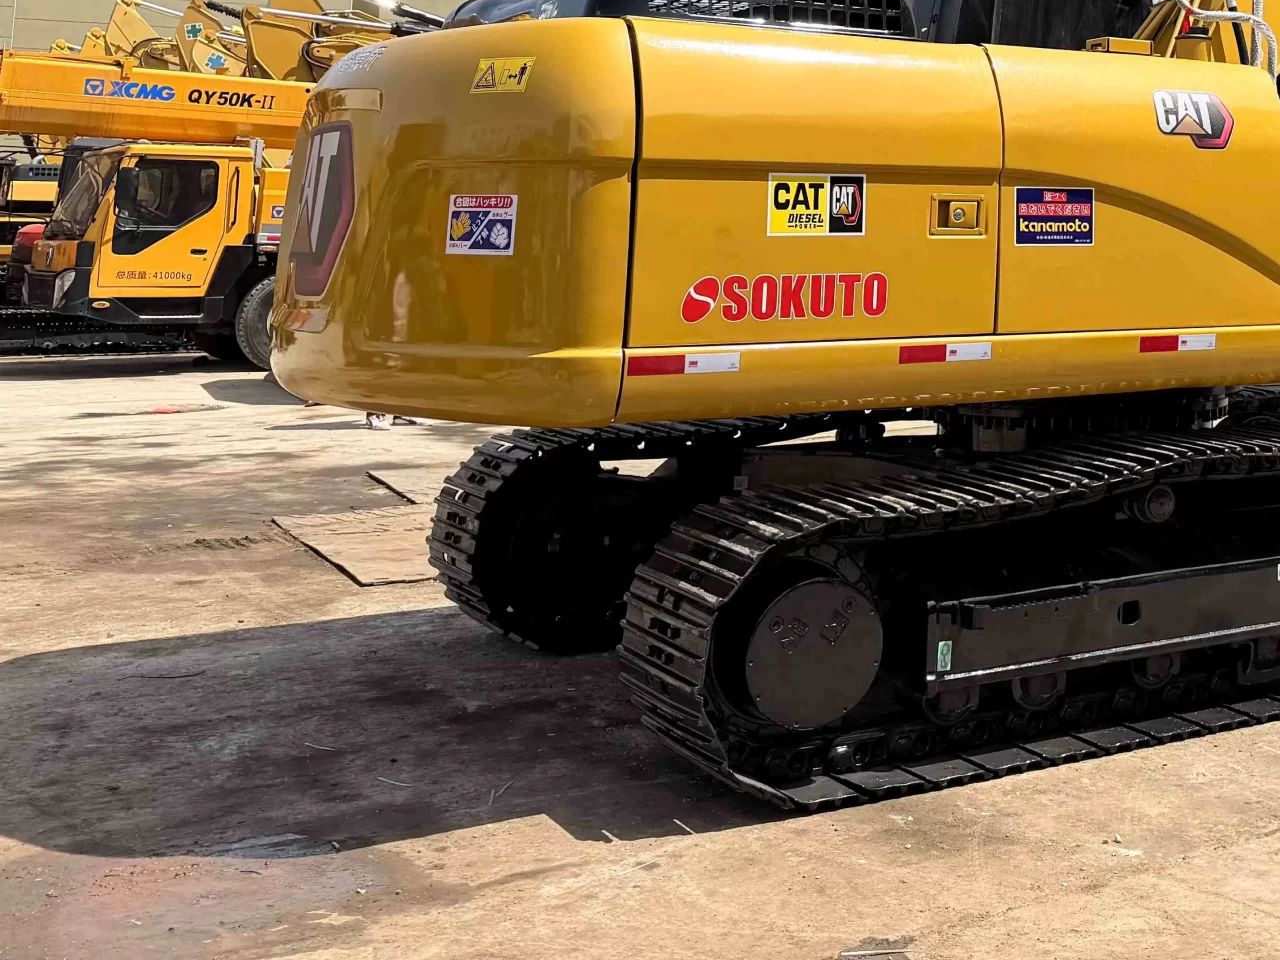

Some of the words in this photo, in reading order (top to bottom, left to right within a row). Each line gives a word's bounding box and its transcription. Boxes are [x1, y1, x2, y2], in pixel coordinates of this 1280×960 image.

[105, 81, 175, 101] XCMG
[1153, 90, 1212, 135] CAT
[300, 131, 340, 252] AT
[773, 182, 825, 211] CAT
[832, 185, 855, 215] CAT
[788, 213, 824, 224] DIESEL
[1019, 218, 1090, 232] kanamoto
[721, 272, 889, 323] SOKUTO
